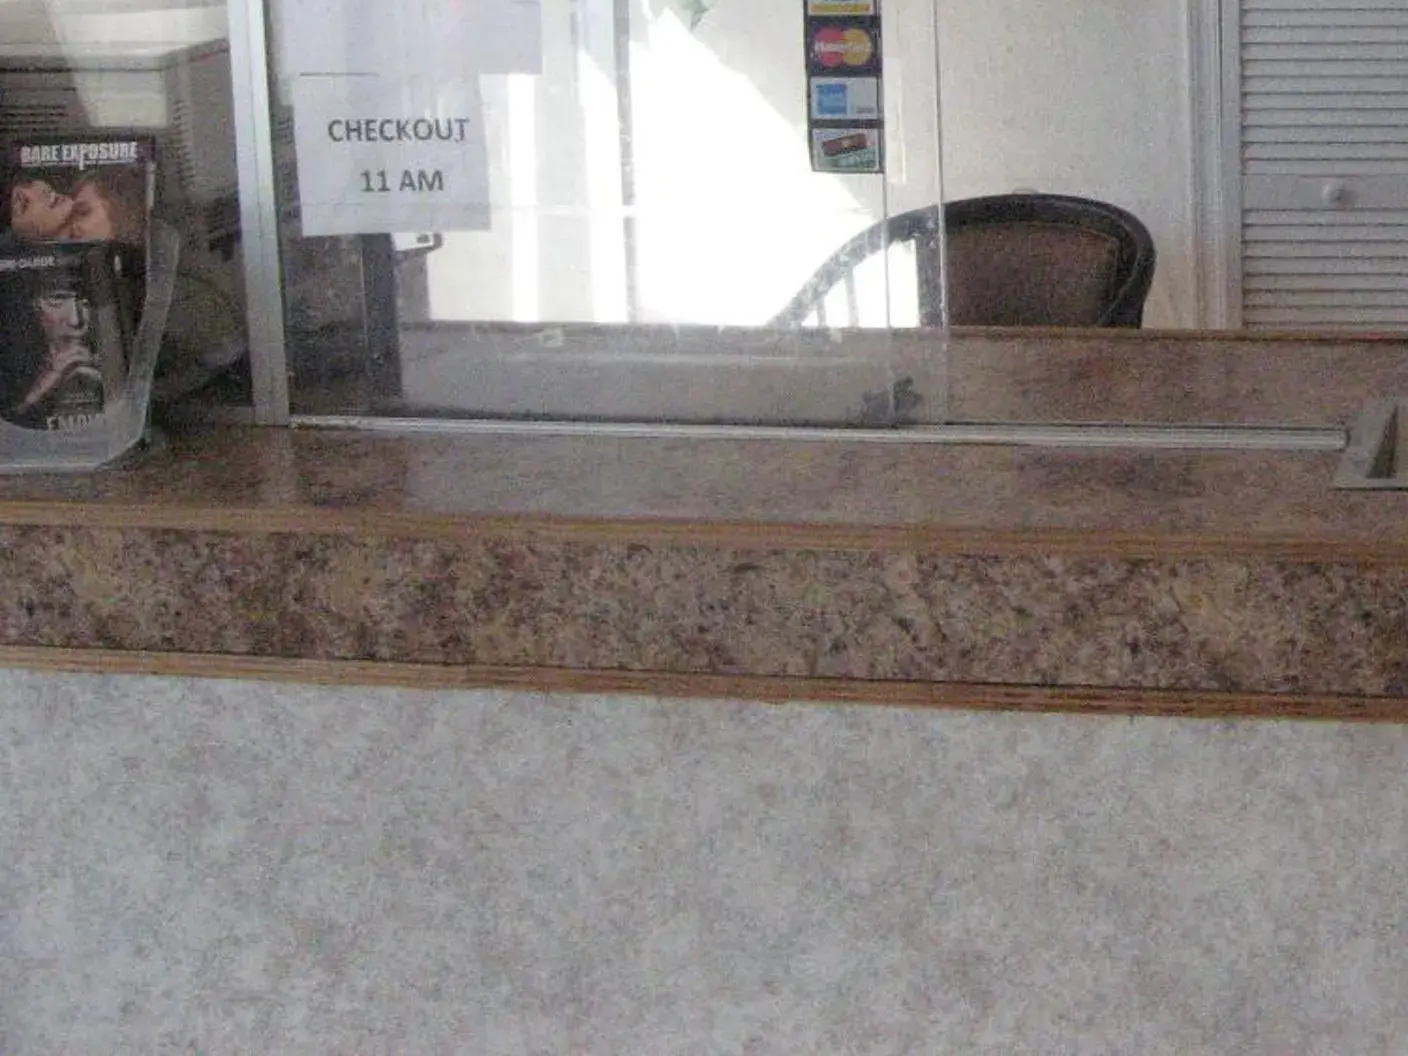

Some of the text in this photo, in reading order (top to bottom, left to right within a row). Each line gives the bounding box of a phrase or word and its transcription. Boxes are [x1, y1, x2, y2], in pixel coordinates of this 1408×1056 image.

[327, 117, 470, 142] CHECKOUT
[20, 141, 139, 171] BARE EXPOSURE
[360, 168, 444, 192] 11 AM
